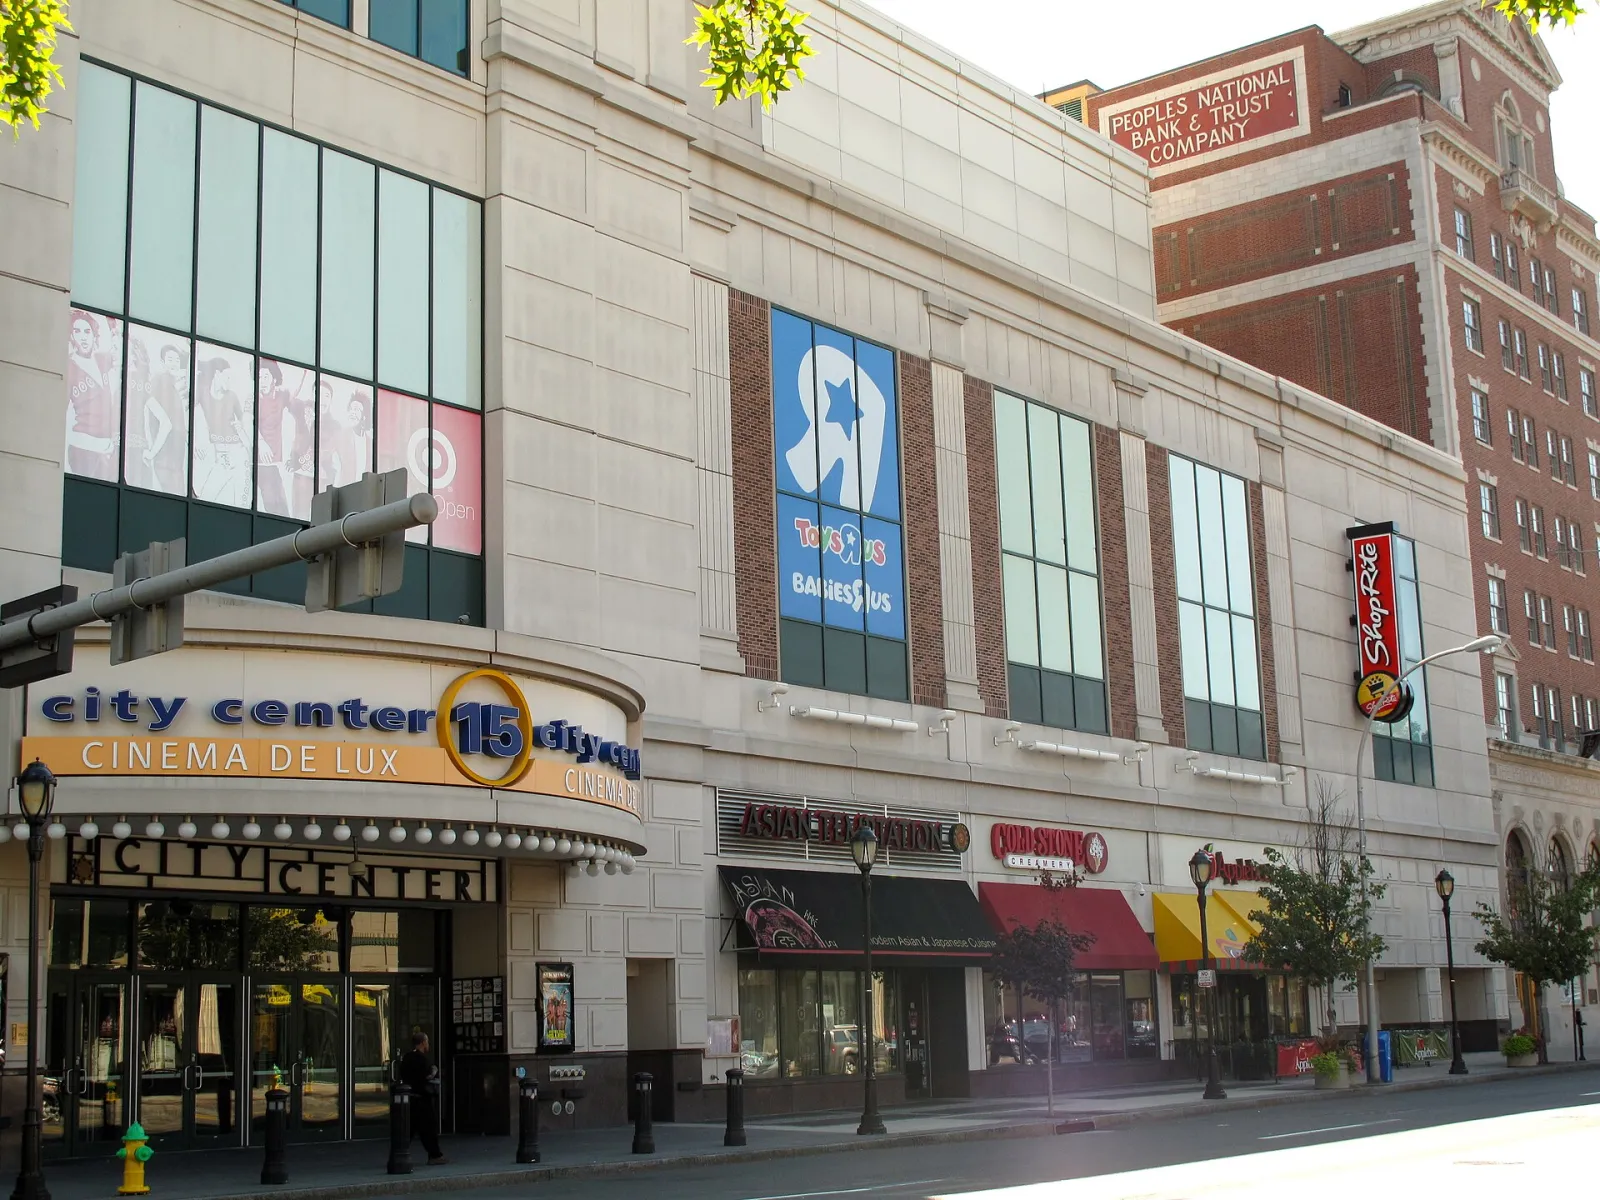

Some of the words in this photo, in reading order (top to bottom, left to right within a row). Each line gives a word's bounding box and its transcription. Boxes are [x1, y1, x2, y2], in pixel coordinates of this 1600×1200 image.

[1112, 97, 1188, 135] PEOPLES
[1198, 66, 1290, 109] NATIONAL
[1131, 118, 1182, 150] BANK
[1189, 113, 1201, 132] &
[1209, 91, 1273, 126] TRUST
[1150, 117, 1251, 164] COMPANY
[42, 686, 188, 732] city
[211, 694, 437, 735] center
[450, 701, 524, 759] 15
[533, 718, 603, 763] city
[81, 741, 249, 772] CINEMA
[271, 744, 317, 773] DE
[336, 746, 399, 776] LUX
[565, 768, 623, 805] CINEMA
[740, 802, 812, 841] ASIAN
[991, 823, 1034, 860] COLD
[1034, 827, 1084, 867] STONE
[1011, 857, 1072, 869] CREAMERY
[114, 838, 252, 879] CITY
[278, 862, 472, 901] CENTER
[731, 875, 796, 908] ASIAN
[870, 935, 898, 946] odern
[898, 935, 922, 946] Asian
